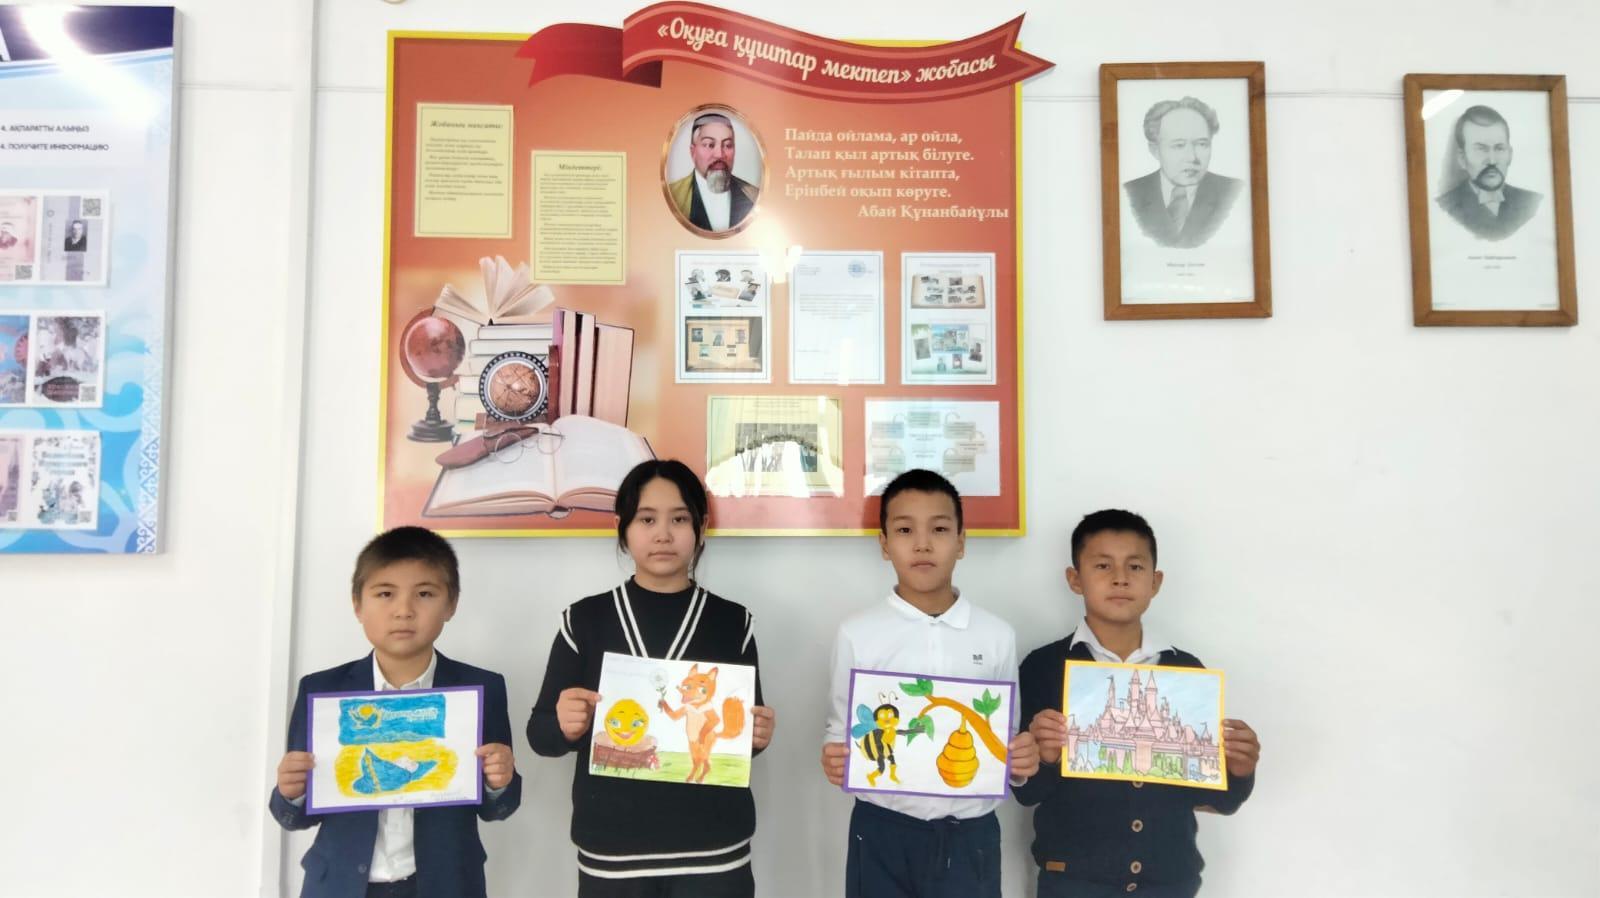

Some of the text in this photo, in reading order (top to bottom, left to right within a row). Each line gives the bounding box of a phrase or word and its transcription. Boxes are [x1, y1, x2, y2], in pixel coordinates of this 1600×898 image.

[657, 17, 997, 84] «Оқуға құштар мектеп» жобасы
[784, 128, 963, 145] Пайда ойлама, ар ойла,
[784, 147, 974, 165] Талап қыл артық білуге.
[785, 165, 961, 181] Артық ғылым кітапта,
[785, 184, 951, 201] Ерінбей оқып көруге.
[857, 205, 1009, 222] Абай Құнанбайұлы
